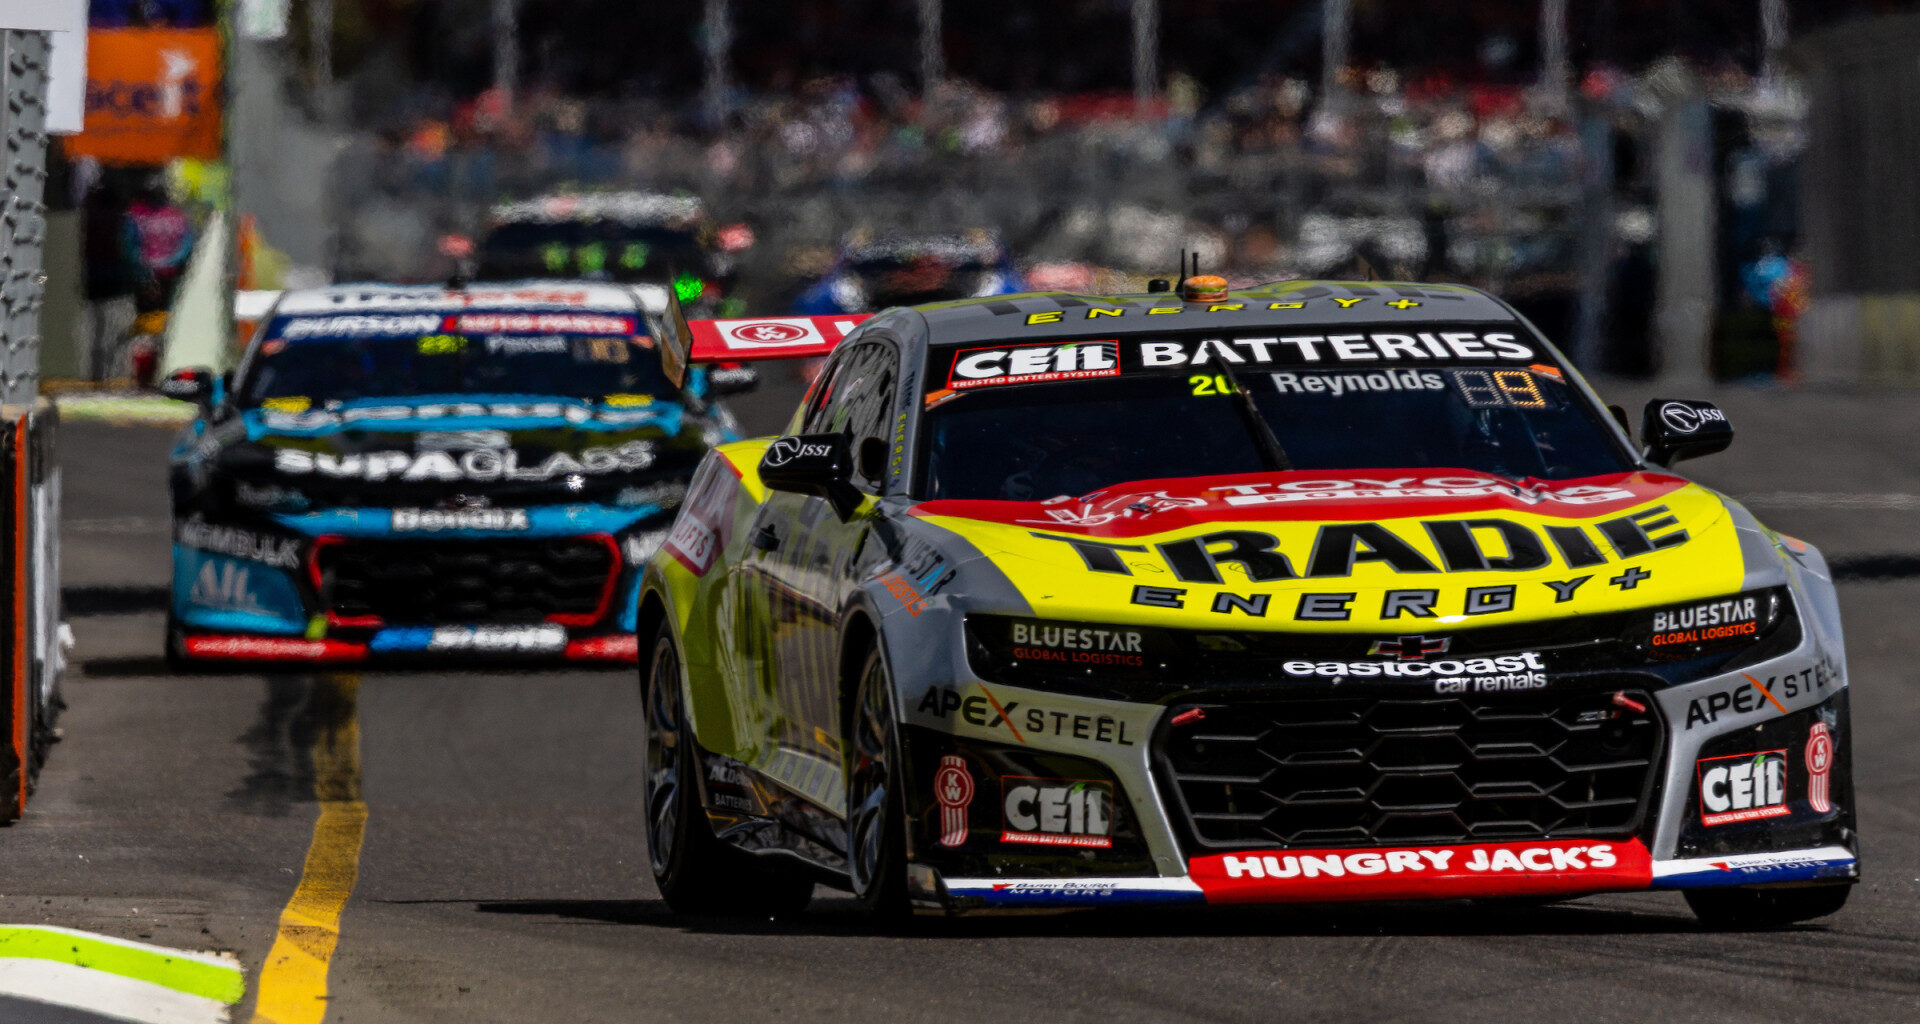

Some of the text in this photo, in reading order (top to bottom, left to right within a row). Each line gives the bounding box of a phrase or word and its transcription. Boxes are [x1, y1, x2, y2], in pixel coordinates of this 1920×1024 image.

[955, 344, 1115, 379] CEIL
[1140, 332, 1534, 366] BATTERIES
[952, 369, 1116, 388] TRUSTED BATTERY SYSTEMS
[1271, 370, 1445, 396] Reynolds
[1696, 408, 1725, 425] JSSI
[795, 444, 832, 458] JSSI
[1028, 505, 1690, 584] TRADIE
[1653, 598, 1757, 632] BLUESTAR
[1013, 623, 1143, 653] BLUESTAR
[1652, 621, 1757, 646] GLOBAL LOGISTICS
[1014, 648, 1144, 666] GLOBAL LOGISTICS
[1282, 652, 1545, 677] eastcoast
[1435, 671, 1547, 694] car rentals
[1685, 672, 1789, 730] APEX
[918, 682, 1134, 746] APEX STEEL
[1702, 755, 1784, 812] CEIL
[1005, 783, 1109, 836] CEIL
[1705, 814, 1734, 825] TRUSTED
[1005, 832, 1109, 846] TRUSTED BATTERY SYSTEMS
[1222, 844, 1617, 878] HUNGRY JACK'S
[1740, 861, 1828, 874] MOTORS
[1009, 888, 1114, 896] MOTORS
